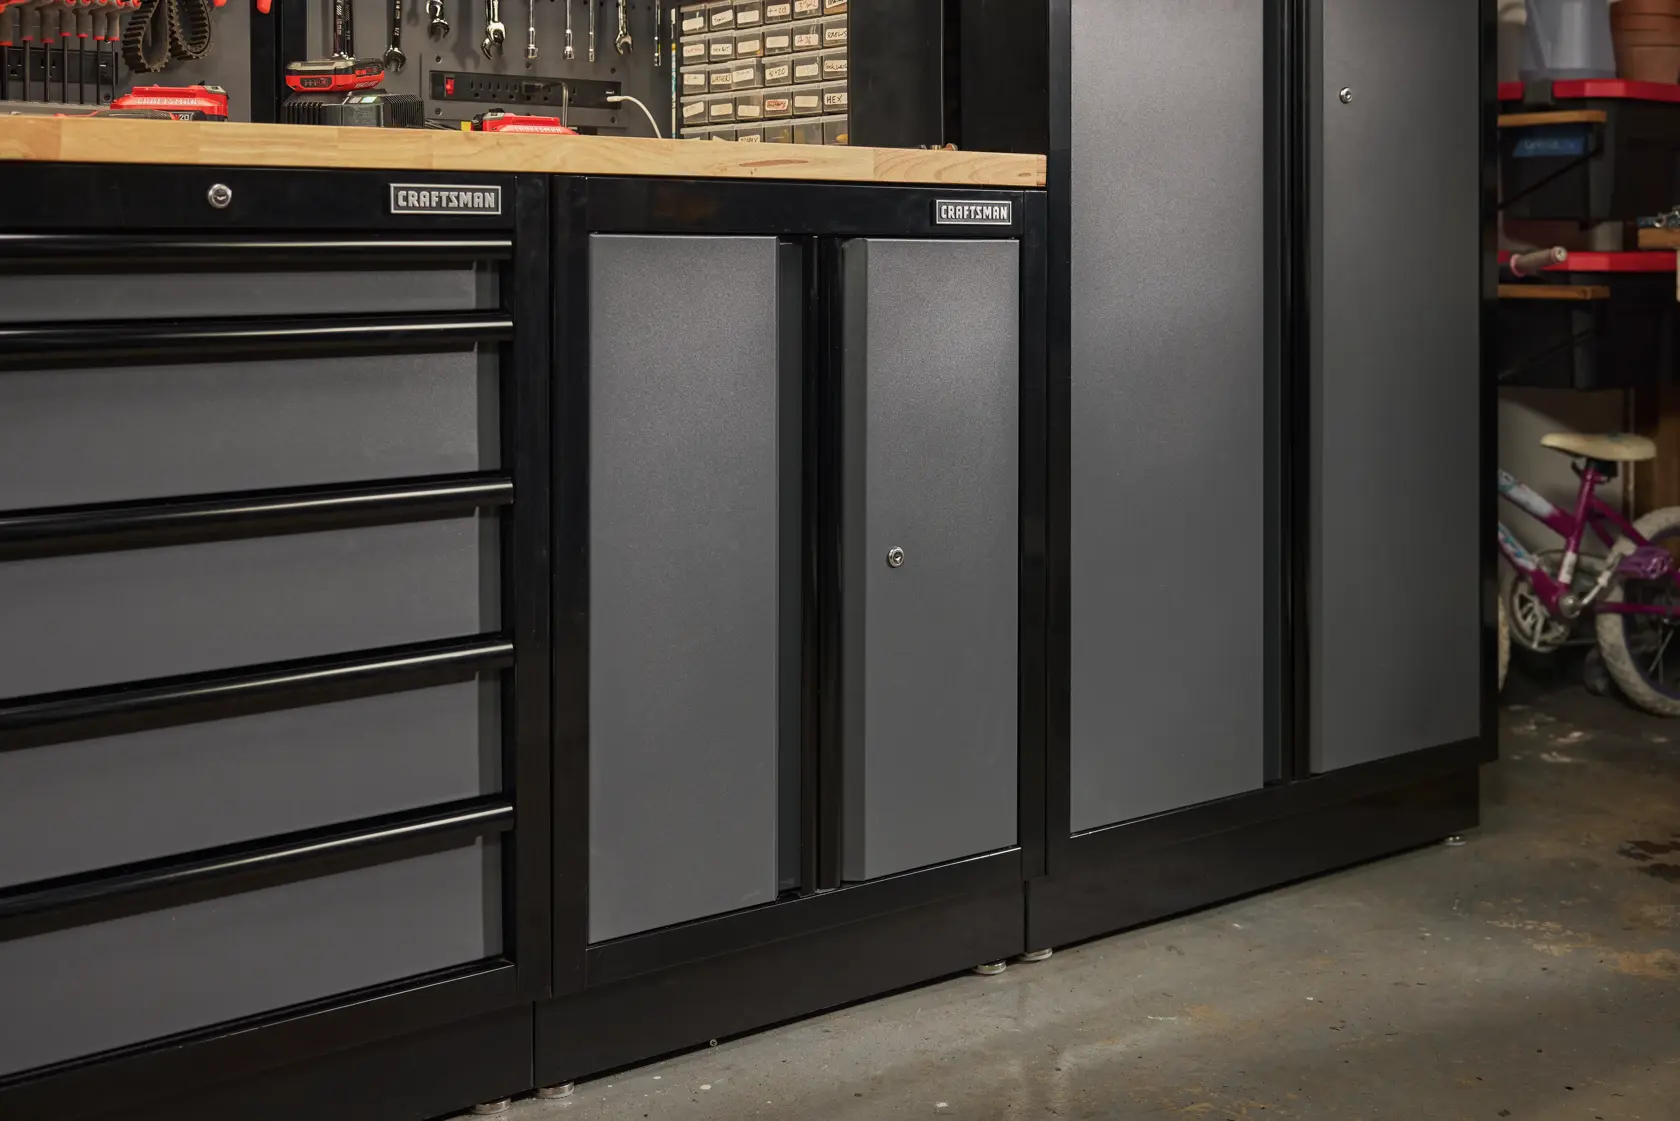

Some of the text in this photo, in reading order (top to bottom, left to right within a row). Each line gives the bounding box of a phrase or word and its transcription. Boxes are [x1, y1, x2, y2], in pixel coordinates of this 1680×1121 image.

[826, 95, 842, 104] HEX
[397, 190, 495, 208] CRAFTSMAN
[940, 205, 1008, 220] CRAFTSMAN
